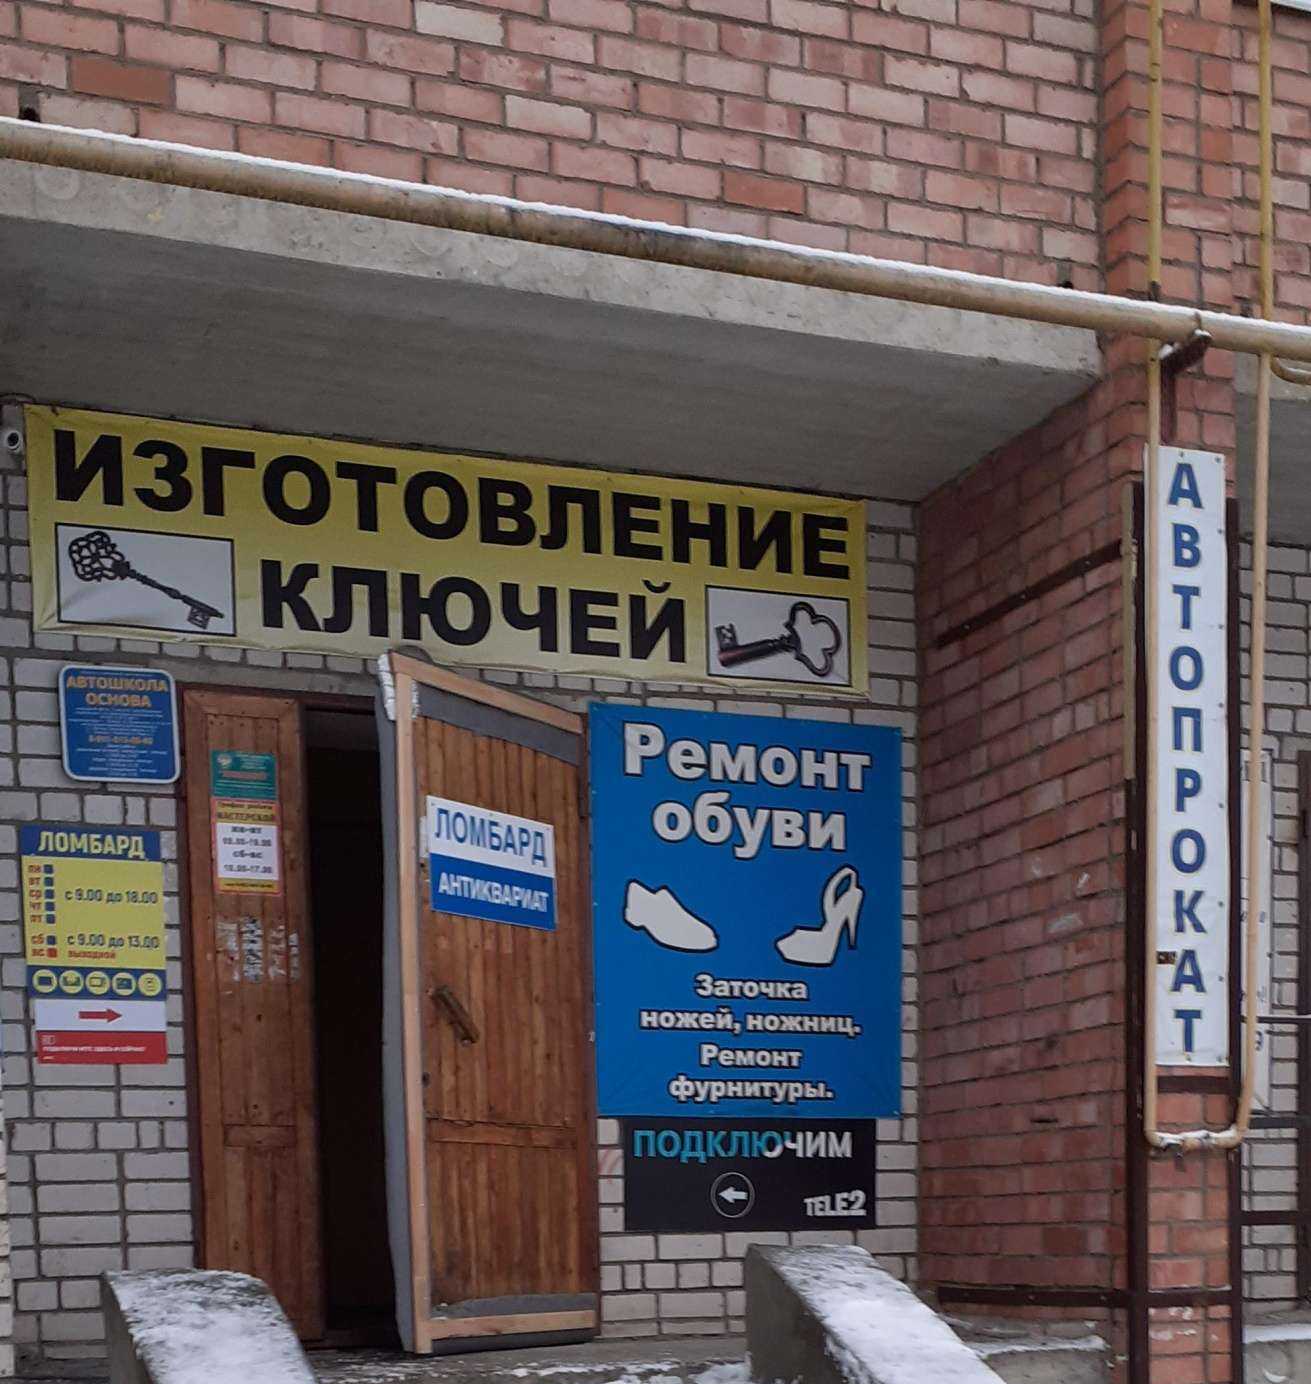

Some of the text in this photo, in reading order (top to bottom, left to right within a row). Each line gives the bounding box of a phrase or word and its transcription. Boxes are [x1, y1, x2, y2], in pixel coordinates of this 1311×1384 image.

[54, 429, 851, 581] ИЗГОТОВЛЕНИЕ
[260, 558, 687, 664] КЛЮЧЕЙ
[66, 675, 168, 693] АВТОШКОЛА
[85, 693, 152, 708] ОСНОВА
[622, 721, 872, 792] Ремонт
[1167, 462, 1207, 1054] АВТОПРОКАТ
[435, 807, 547, 868] ЛОМБАРД
[652, 791, 847, 860] обуви
[38, 831, 146, 860] ЛОМБАРД
[65, 890, 73, 900] с
[75, 888, 102, 901] 9.00
[106, 892, 122, 903] до
[438, 872, 549, 913] АНТИКВАРИАТ
[67, 935, 75, 945] с
[77, 933, 105, 947] 9.00
[108, 936, 124, 948] до
[695, 973, 807, 999] Заточка
[640, 1008, 861, 1036] ножей, ножниц.
[700, 1043, 802, 1068] Ремонт
[668, 1074, 833, 1103] фурнитуры.
[633, 1128, 852, 1165] ПОДКЛЮЧИМ
[804, 1189, 866, 1217] TELE2
